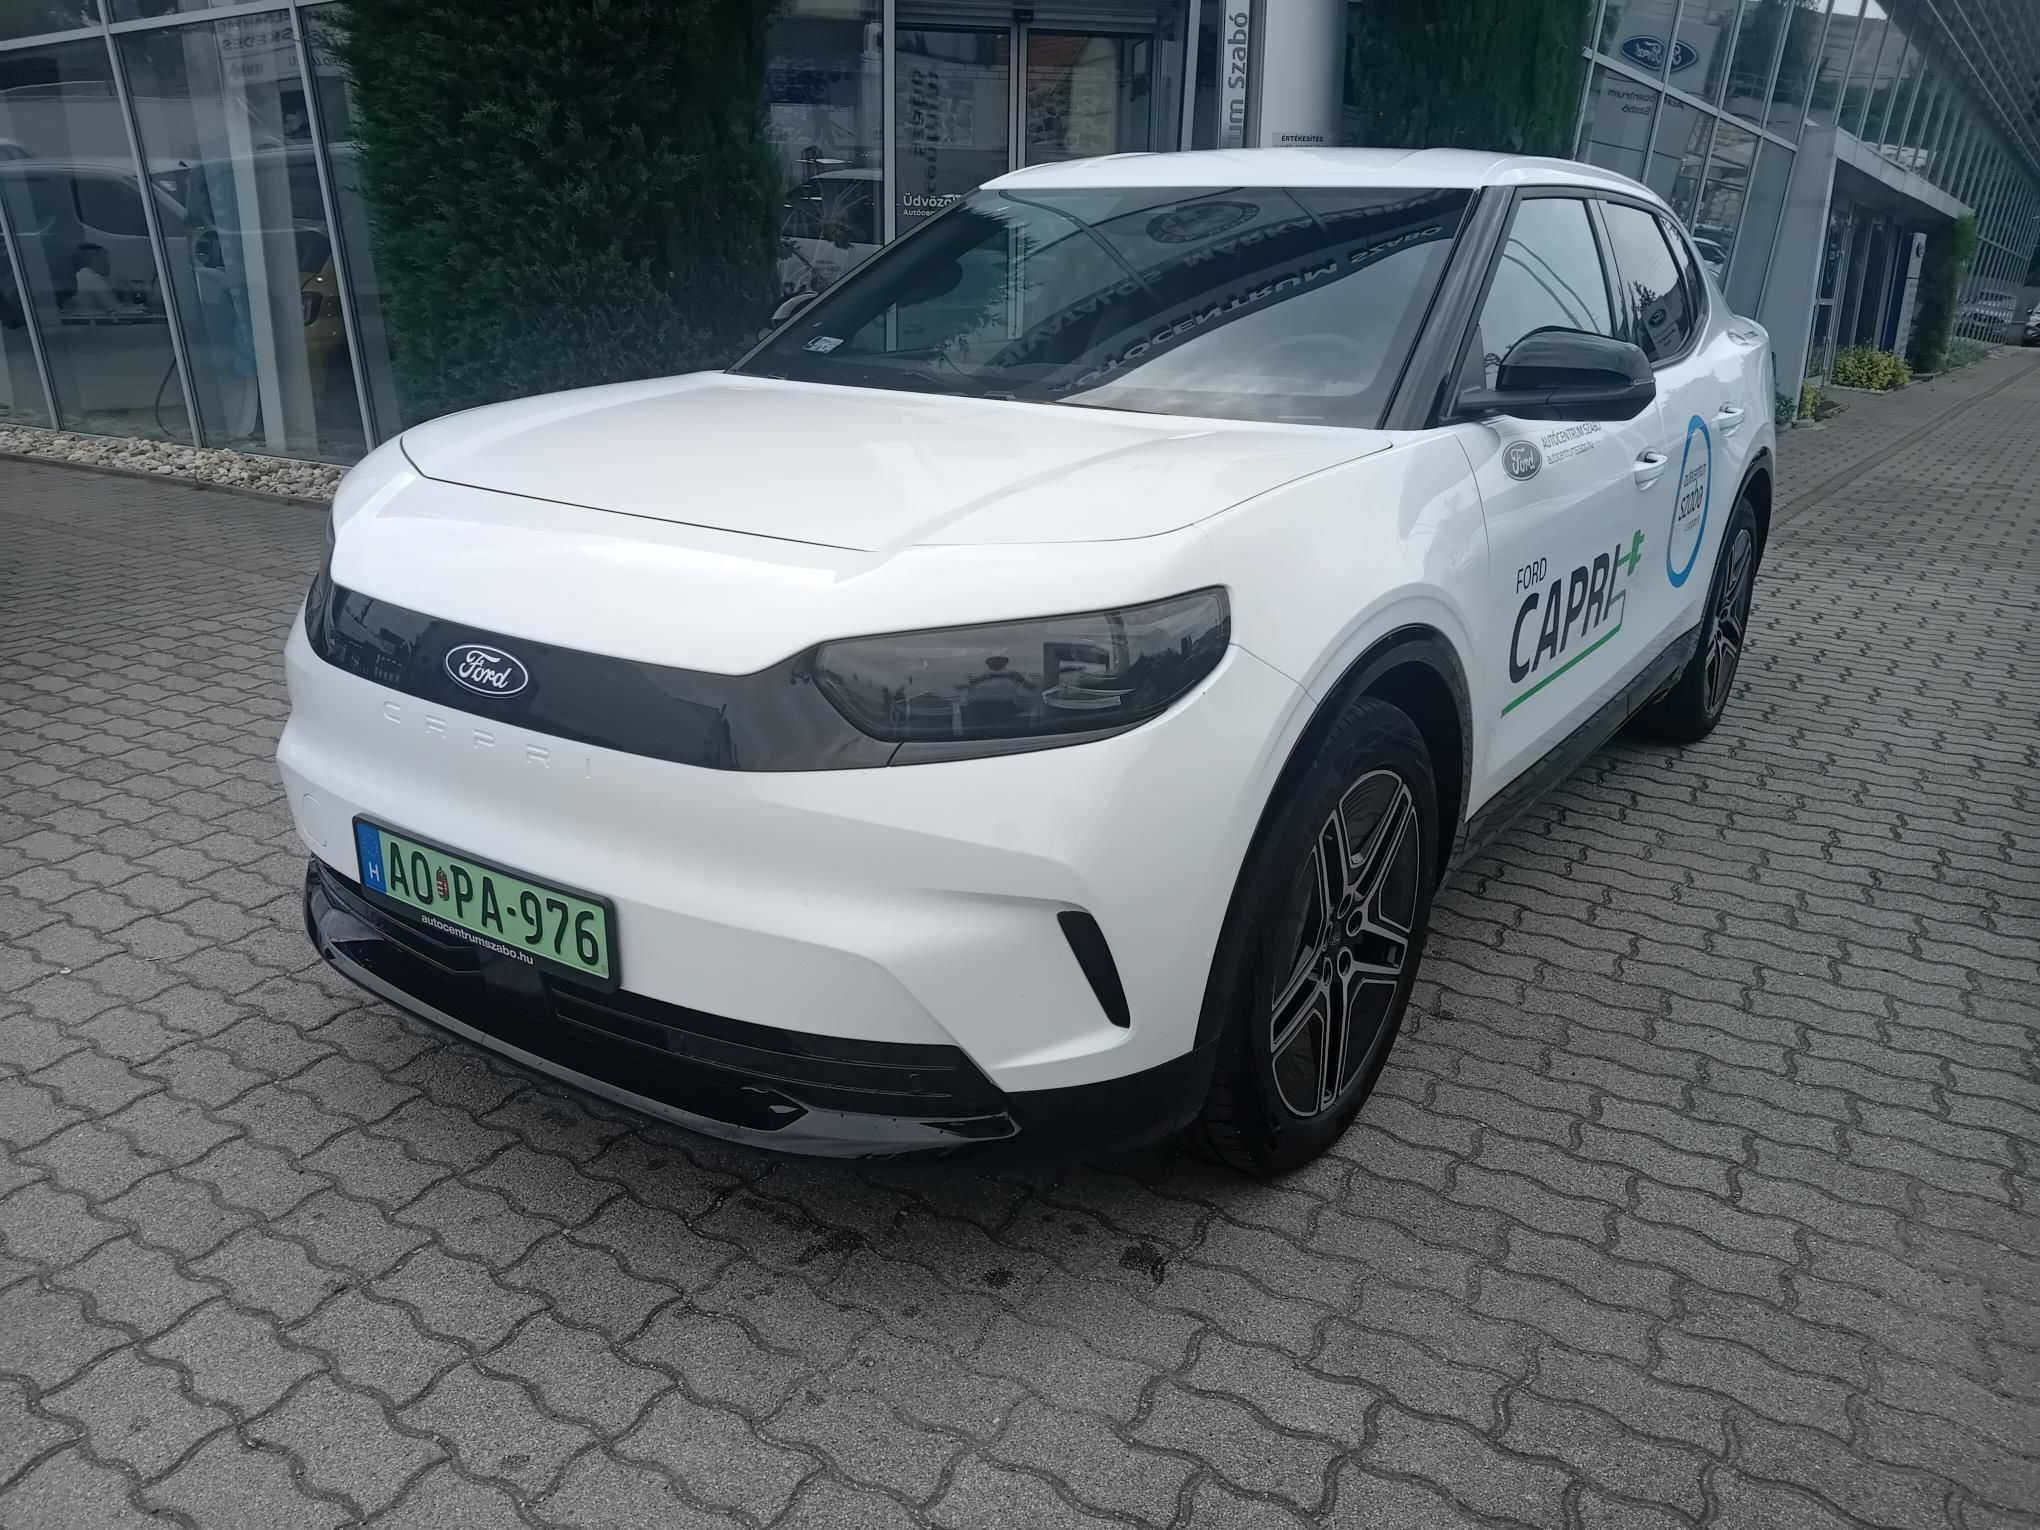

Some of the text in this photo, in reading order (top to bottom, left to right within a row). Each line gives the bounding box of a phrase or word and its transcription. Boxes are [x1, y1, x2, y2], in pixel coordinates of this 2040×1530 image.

[1227, 13, 1248, 89] Szabó
[1516, 556, 1548, 595] FORD
[1509, 542, 1622, 684] CAPRI
[458, 649, 514, 689] Ford
[382, 699, 594, 780] CAPRI
[368, 861, 380, 882] H
[390, 842, 600, 966] AO PA-976
[421, 913, 536, 966] autocentrumszabo.hu
